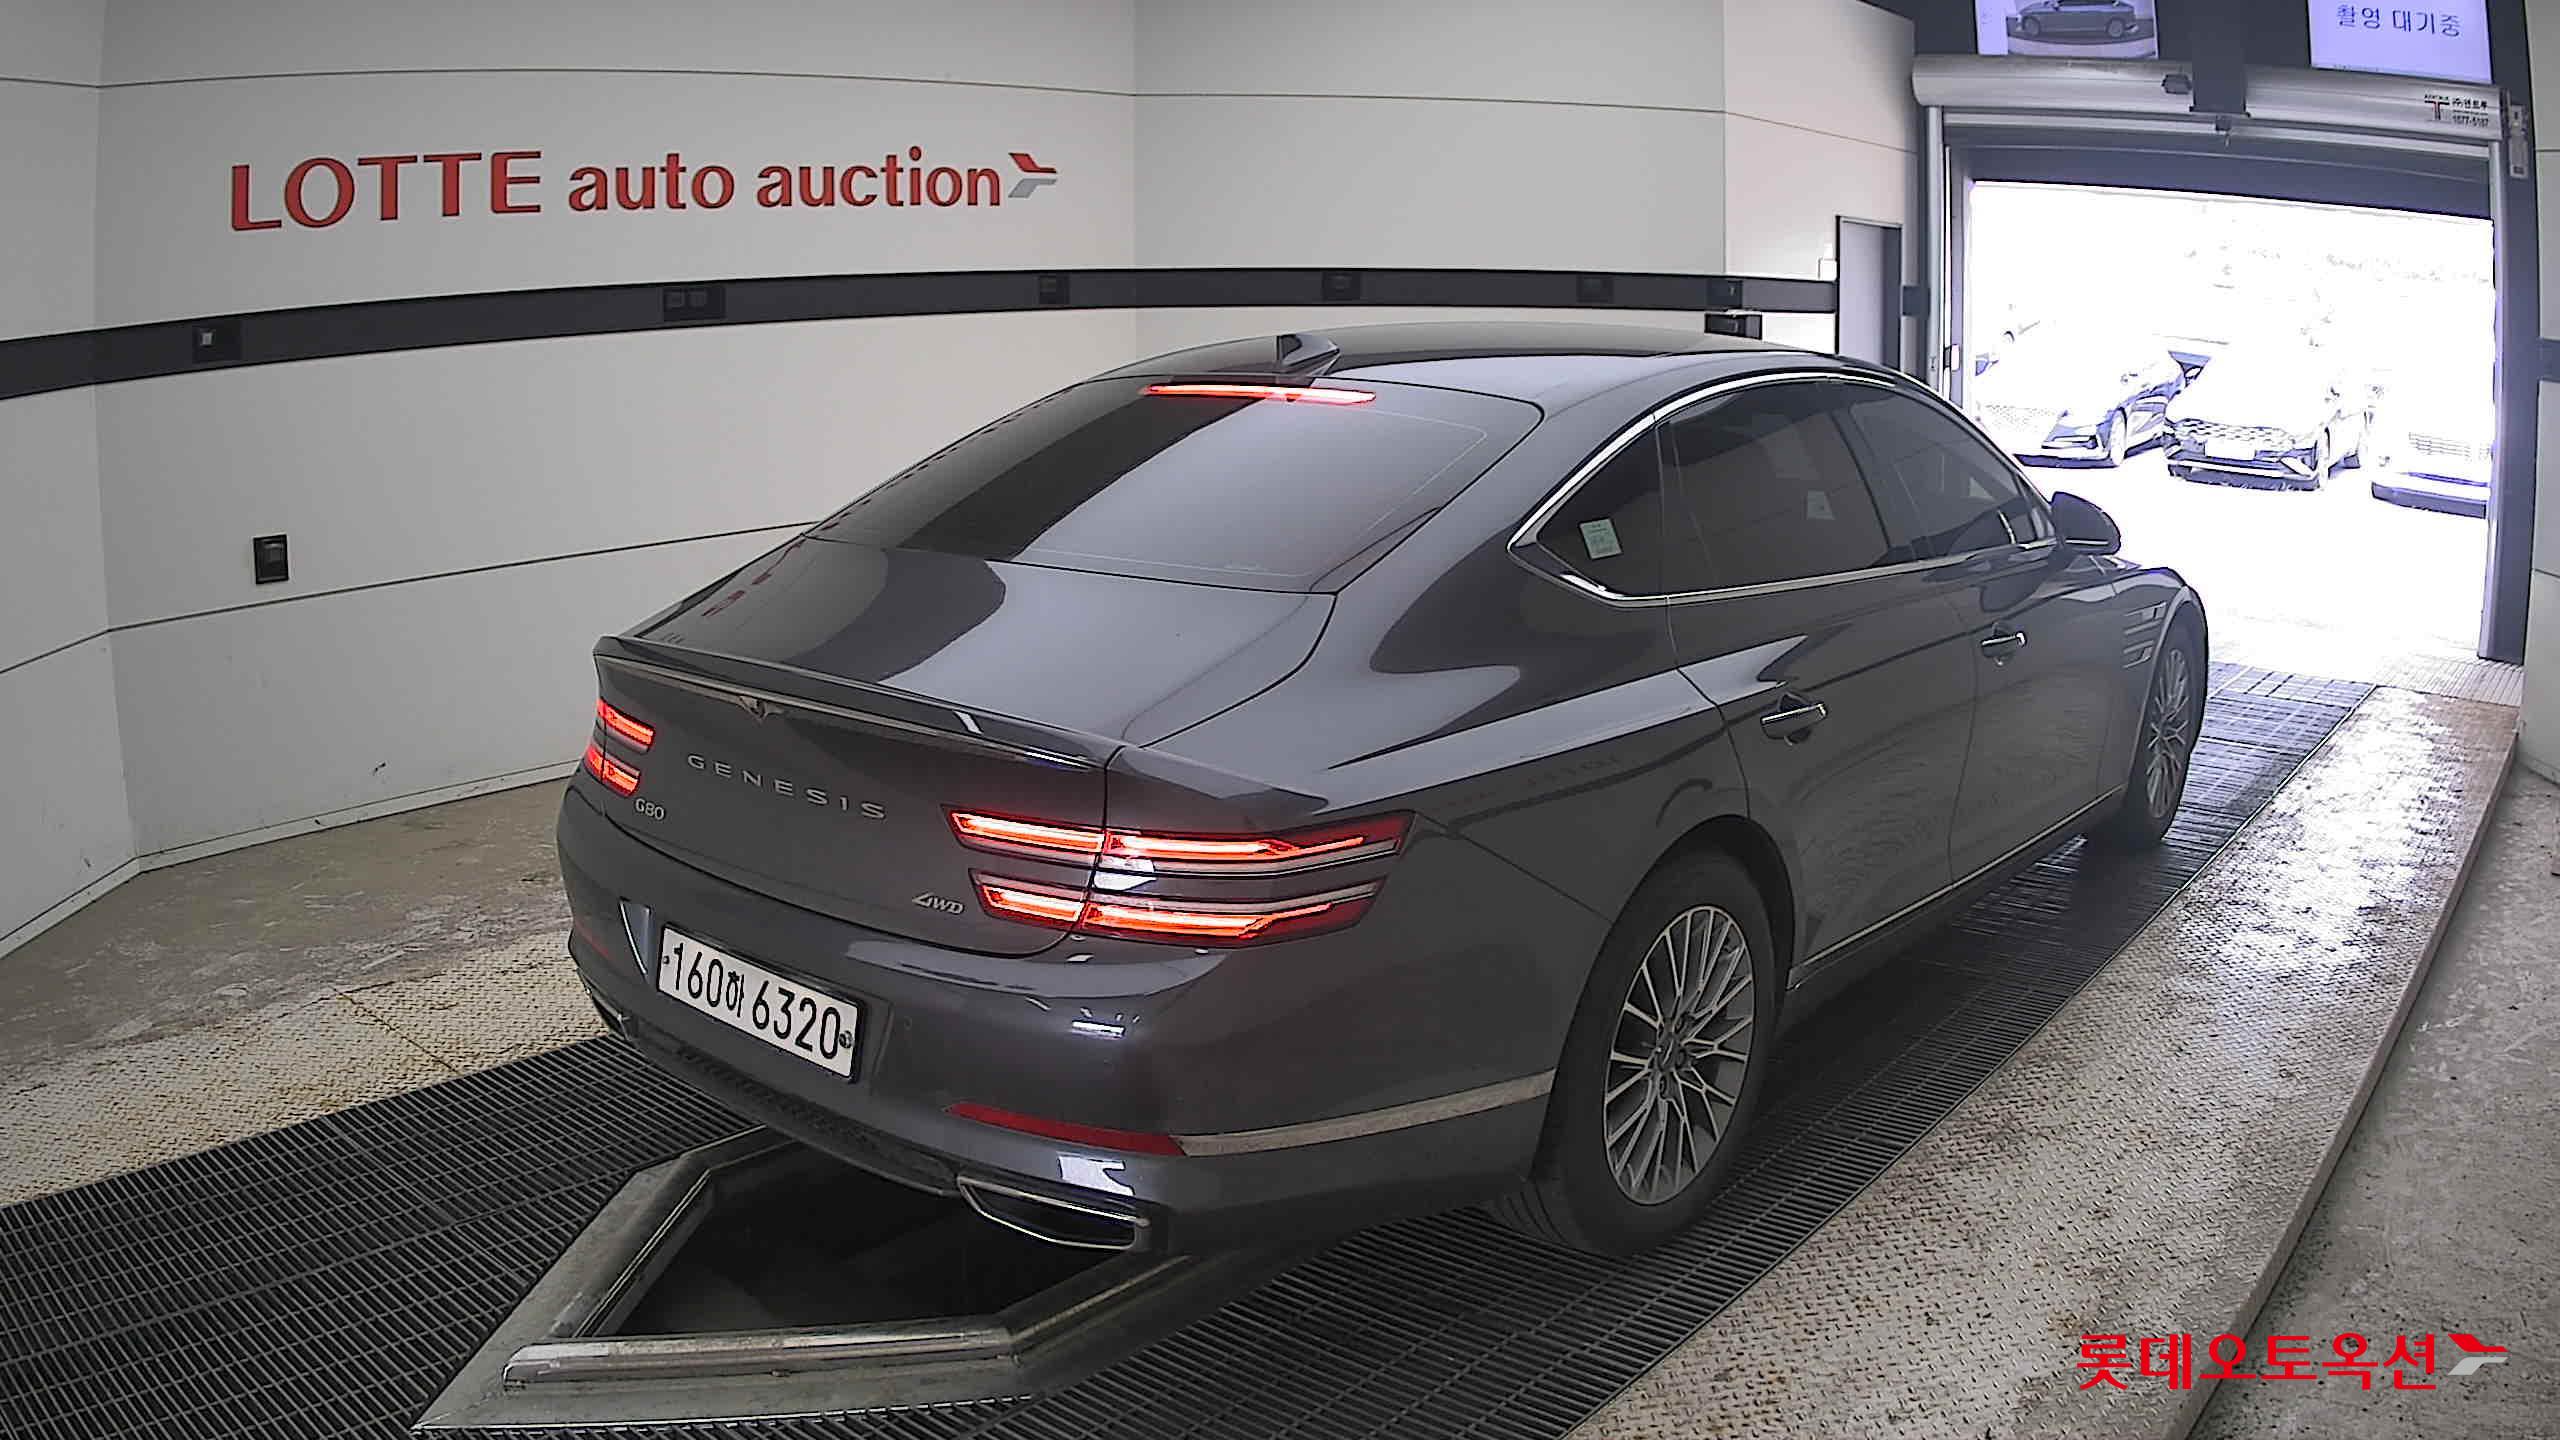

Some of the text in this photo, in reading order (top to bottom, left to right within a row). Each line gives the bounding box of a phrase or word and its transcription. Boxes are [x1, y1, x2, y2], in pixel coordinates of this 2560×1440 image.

[2337, 5, 2461, 37] 촬영 대기중
[231, 146, 1002, 232] LOTTE auto auction
[634, 797, 665, 821] G80
[687, 753, 887, 821] GENESIS
